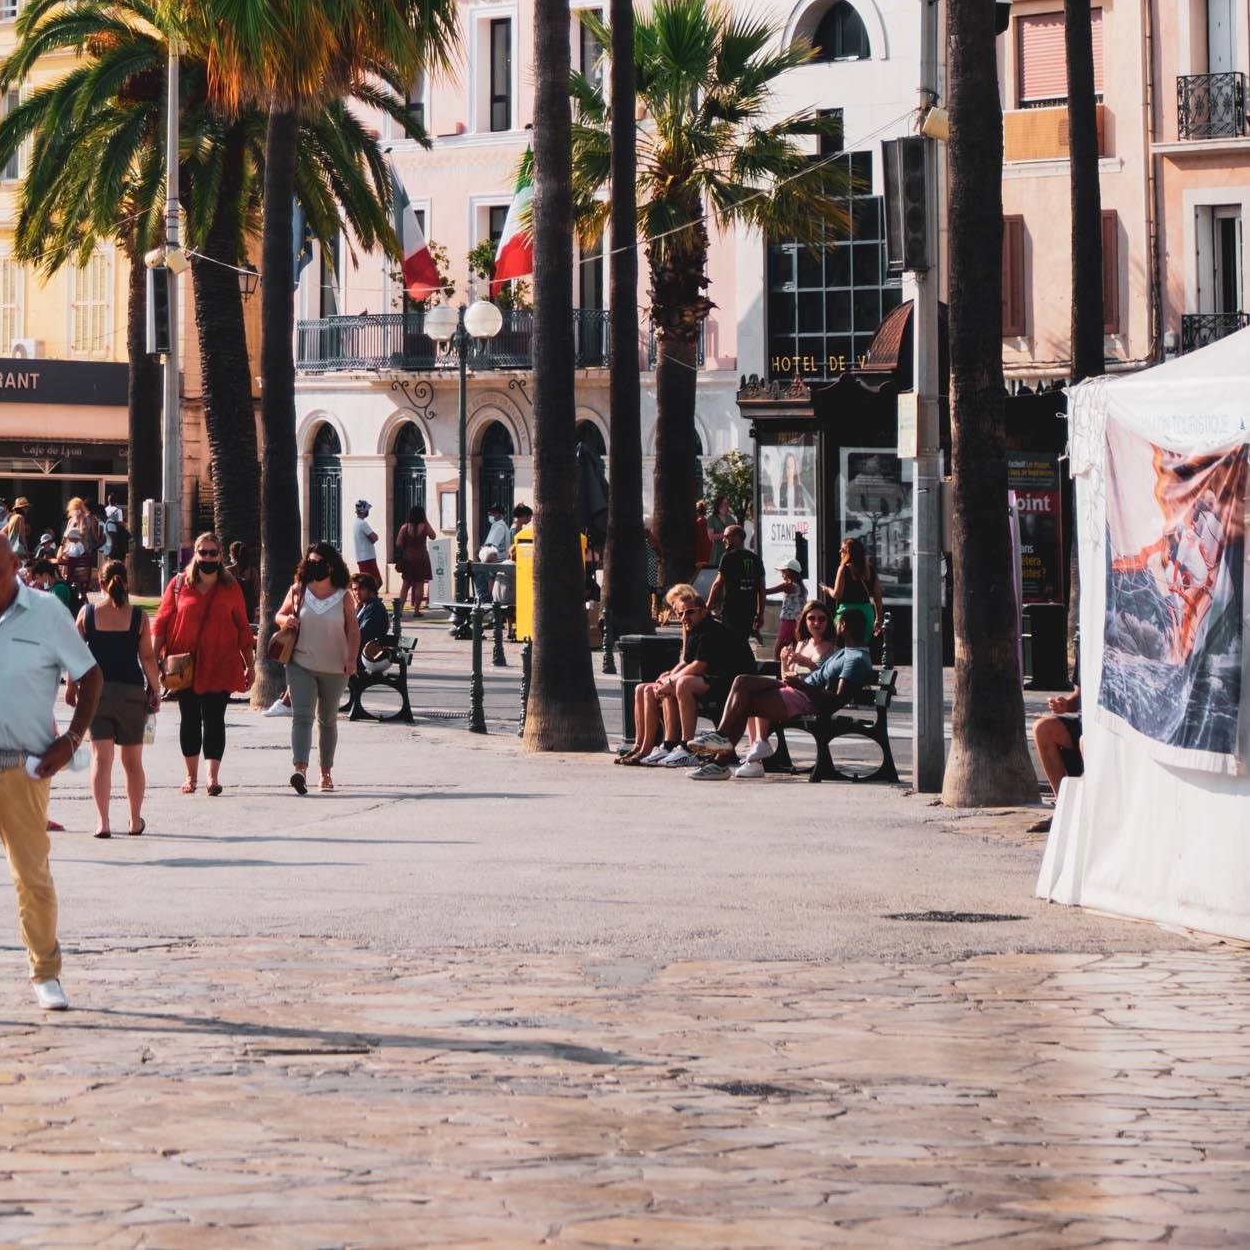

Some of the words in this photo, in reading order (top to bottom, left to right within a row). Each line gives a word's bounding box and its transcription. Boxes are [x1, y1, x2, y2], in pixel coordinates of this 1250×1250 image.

[771, 355, 819, 372] HOTEL
[829, 355, 846, 371] DE
[1014, 492, 1051, 511] oint
